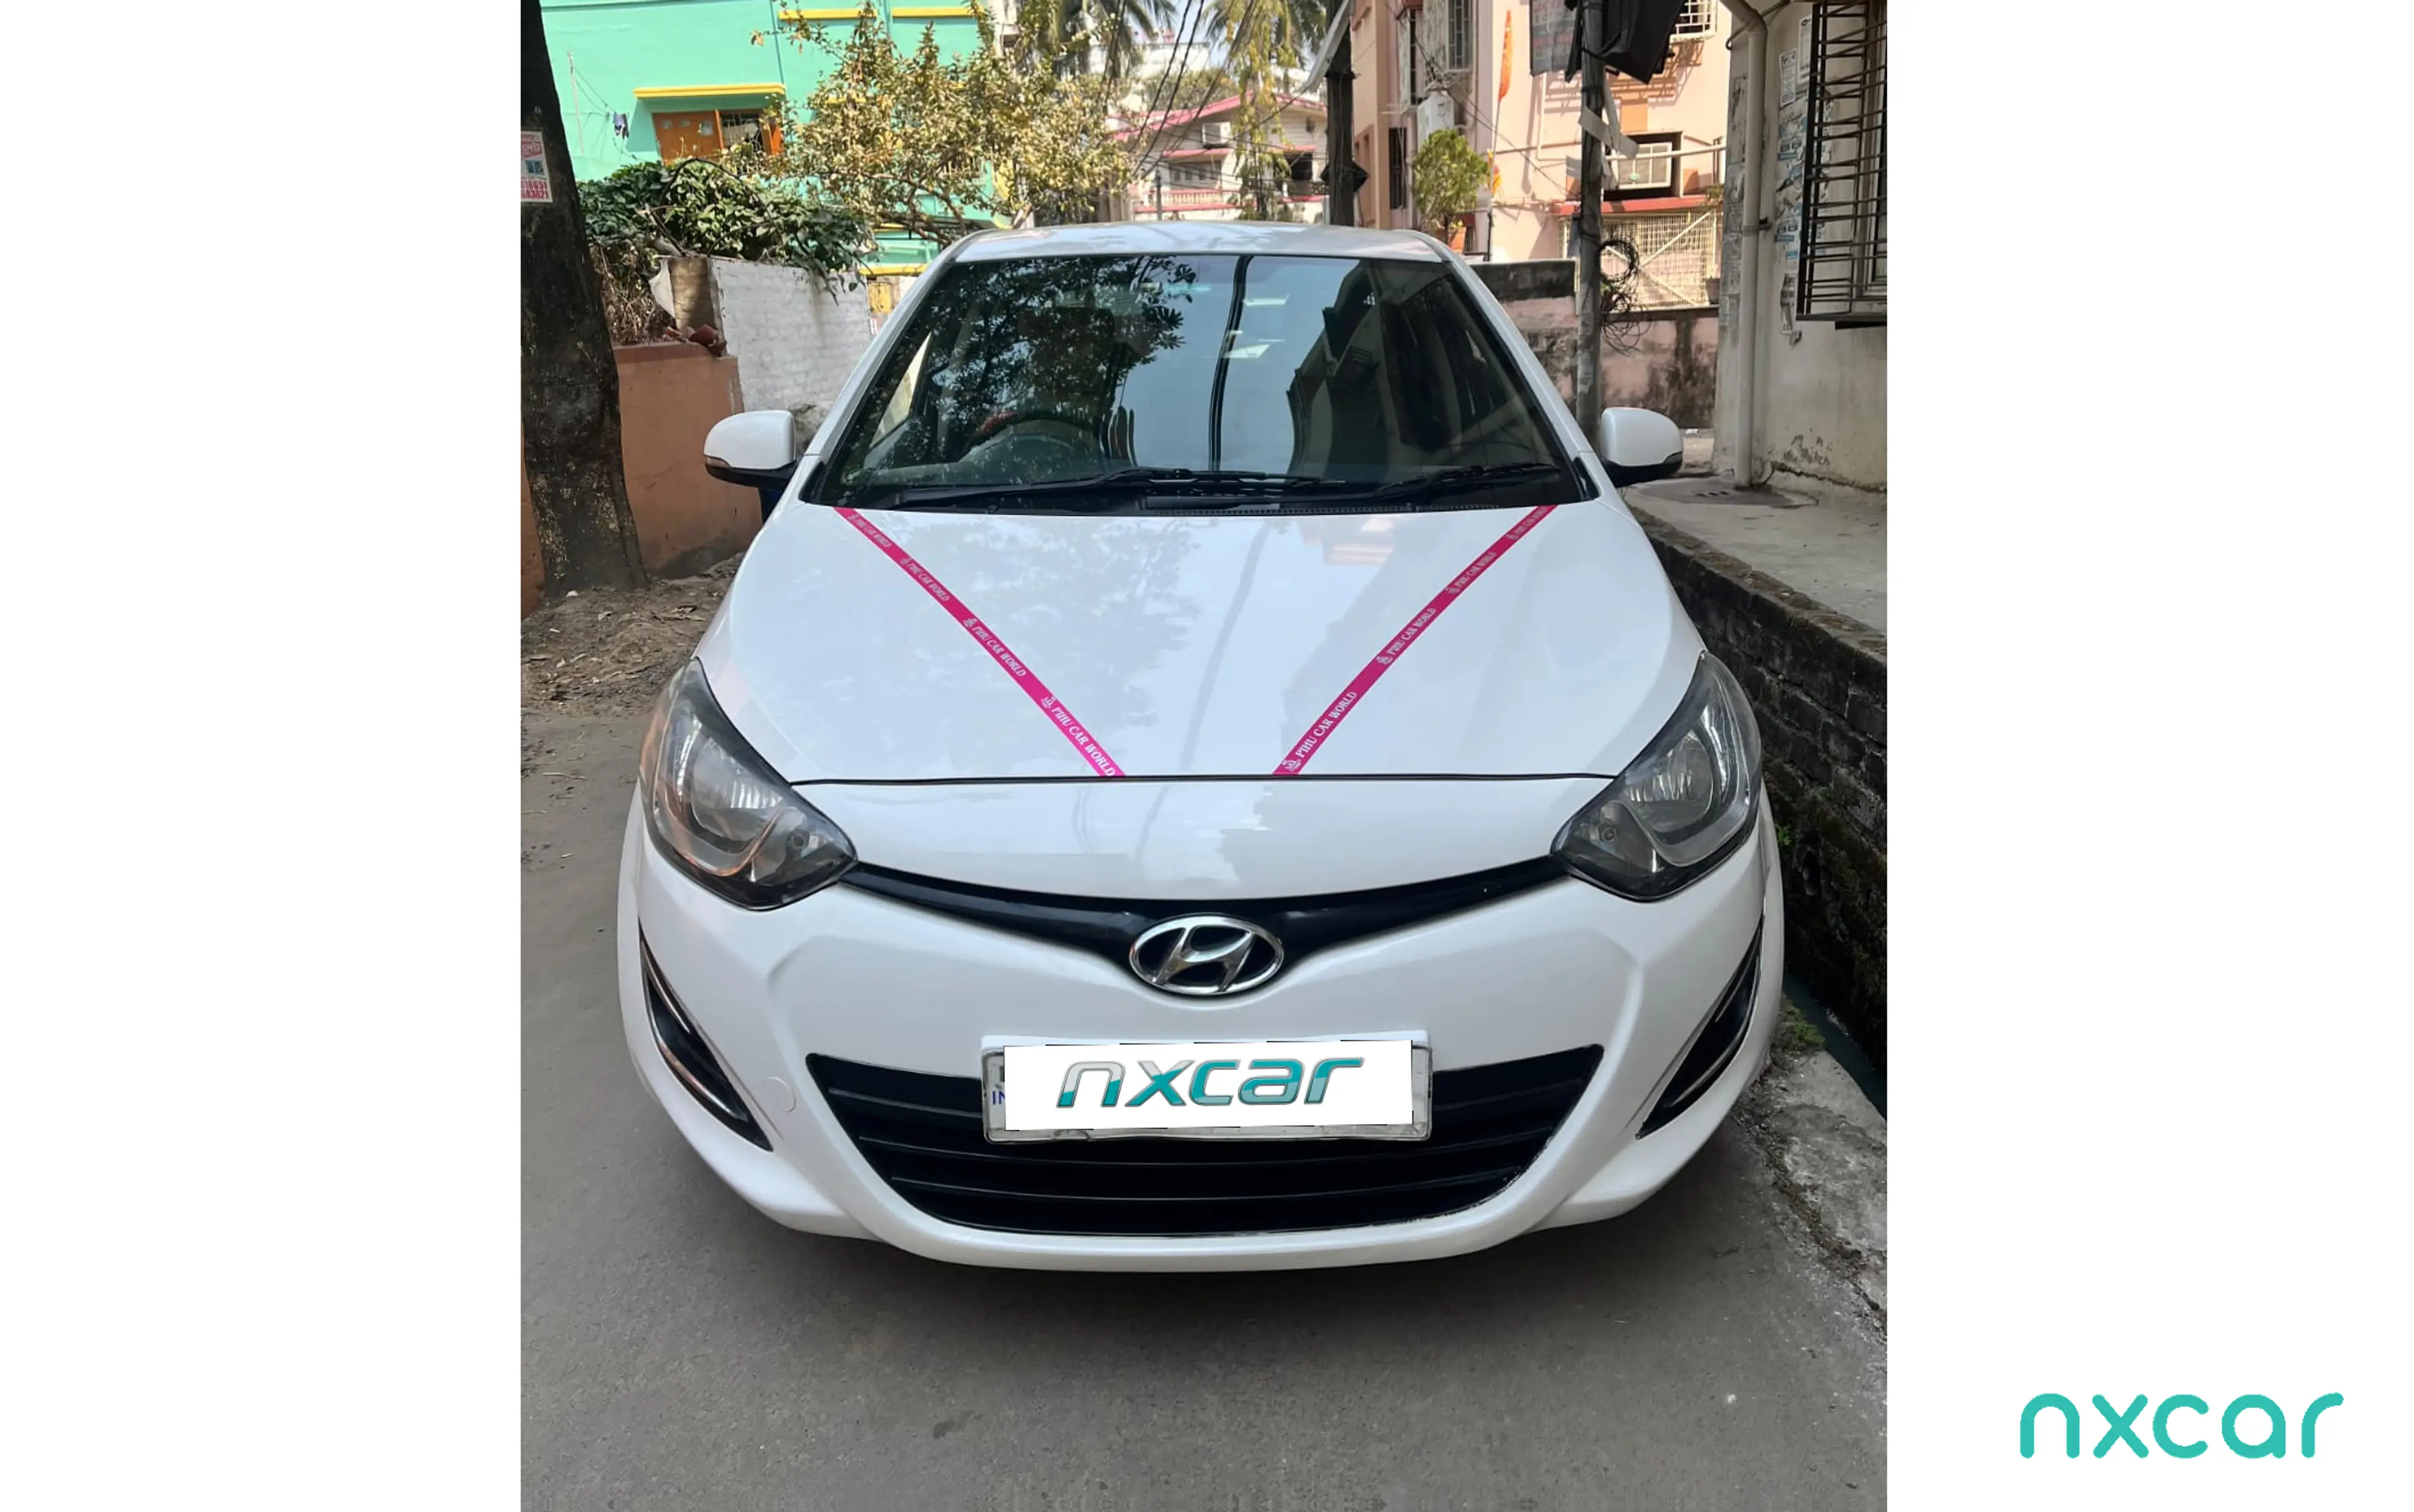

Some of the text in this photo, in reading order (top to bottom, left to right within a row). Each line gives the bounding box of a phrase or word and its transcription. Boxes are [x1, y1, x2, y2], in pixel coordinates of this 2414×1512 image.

[1000, 653, 1027, 677] WORLD
[1295, 691, 1358, 758] PIHU CAR WORLD
[1069, 726, 1089, 746] CAR
[1084, 743, 1116, 776] WORLD
